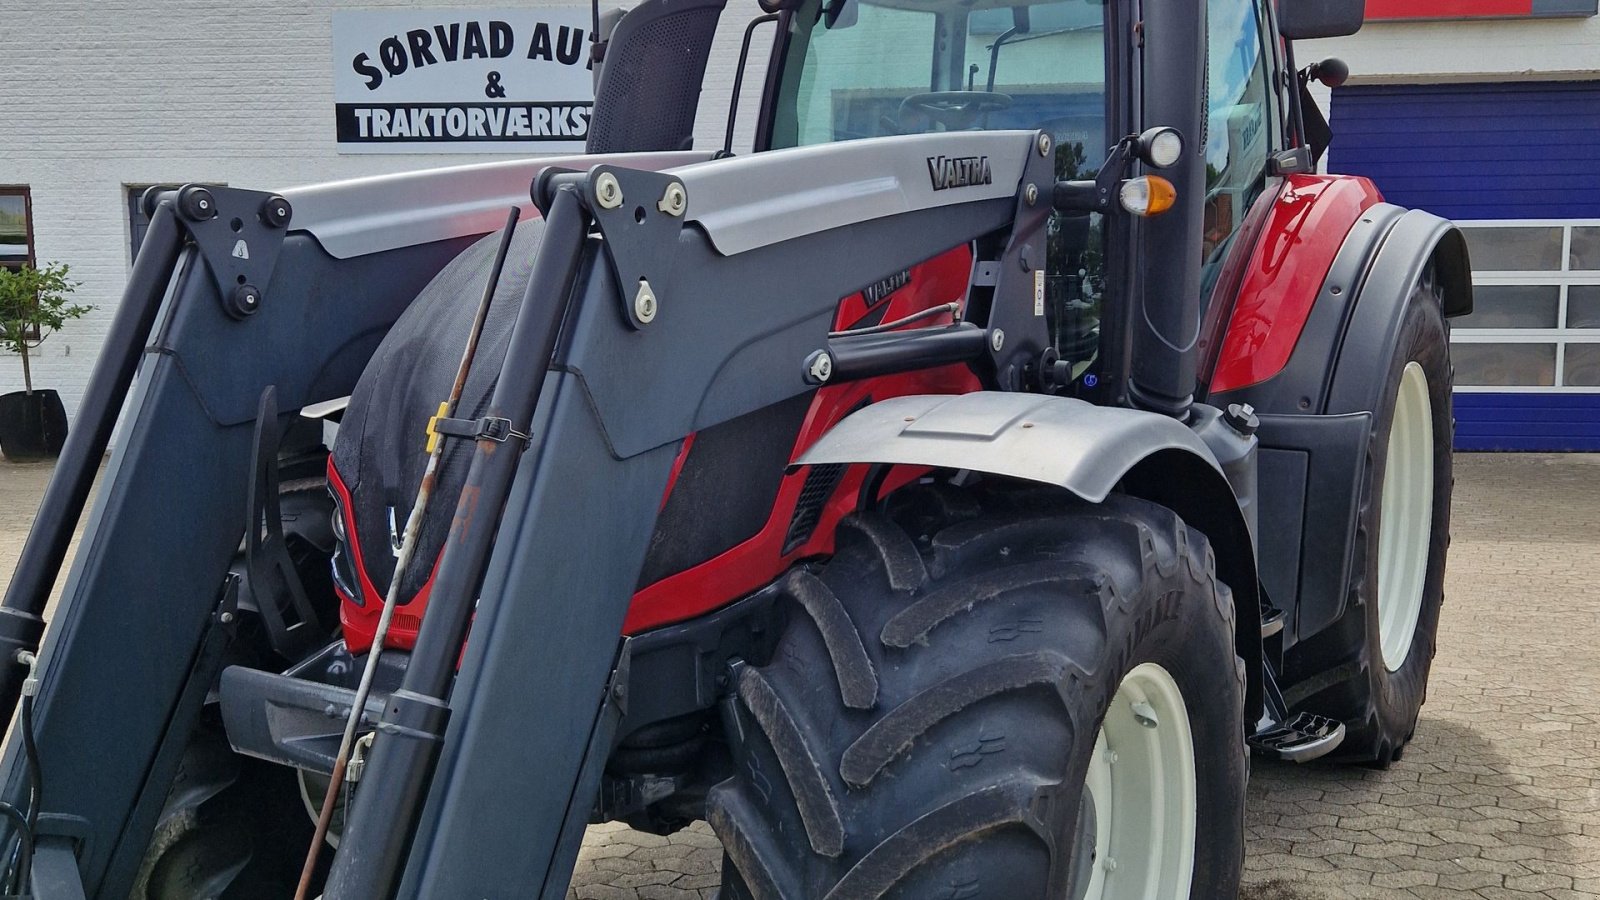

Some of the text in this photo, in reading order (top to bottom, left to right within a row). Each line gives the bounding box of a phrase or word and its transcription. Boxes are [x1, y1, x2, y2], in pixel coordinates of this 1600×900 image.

[353, 21, 514, 90] SØRVAD
[485, 71, 506, 98] &
[355, 106, 593, 138] TRAKTORVÆRKS
[926, 155, 992, 191] VALTRA
